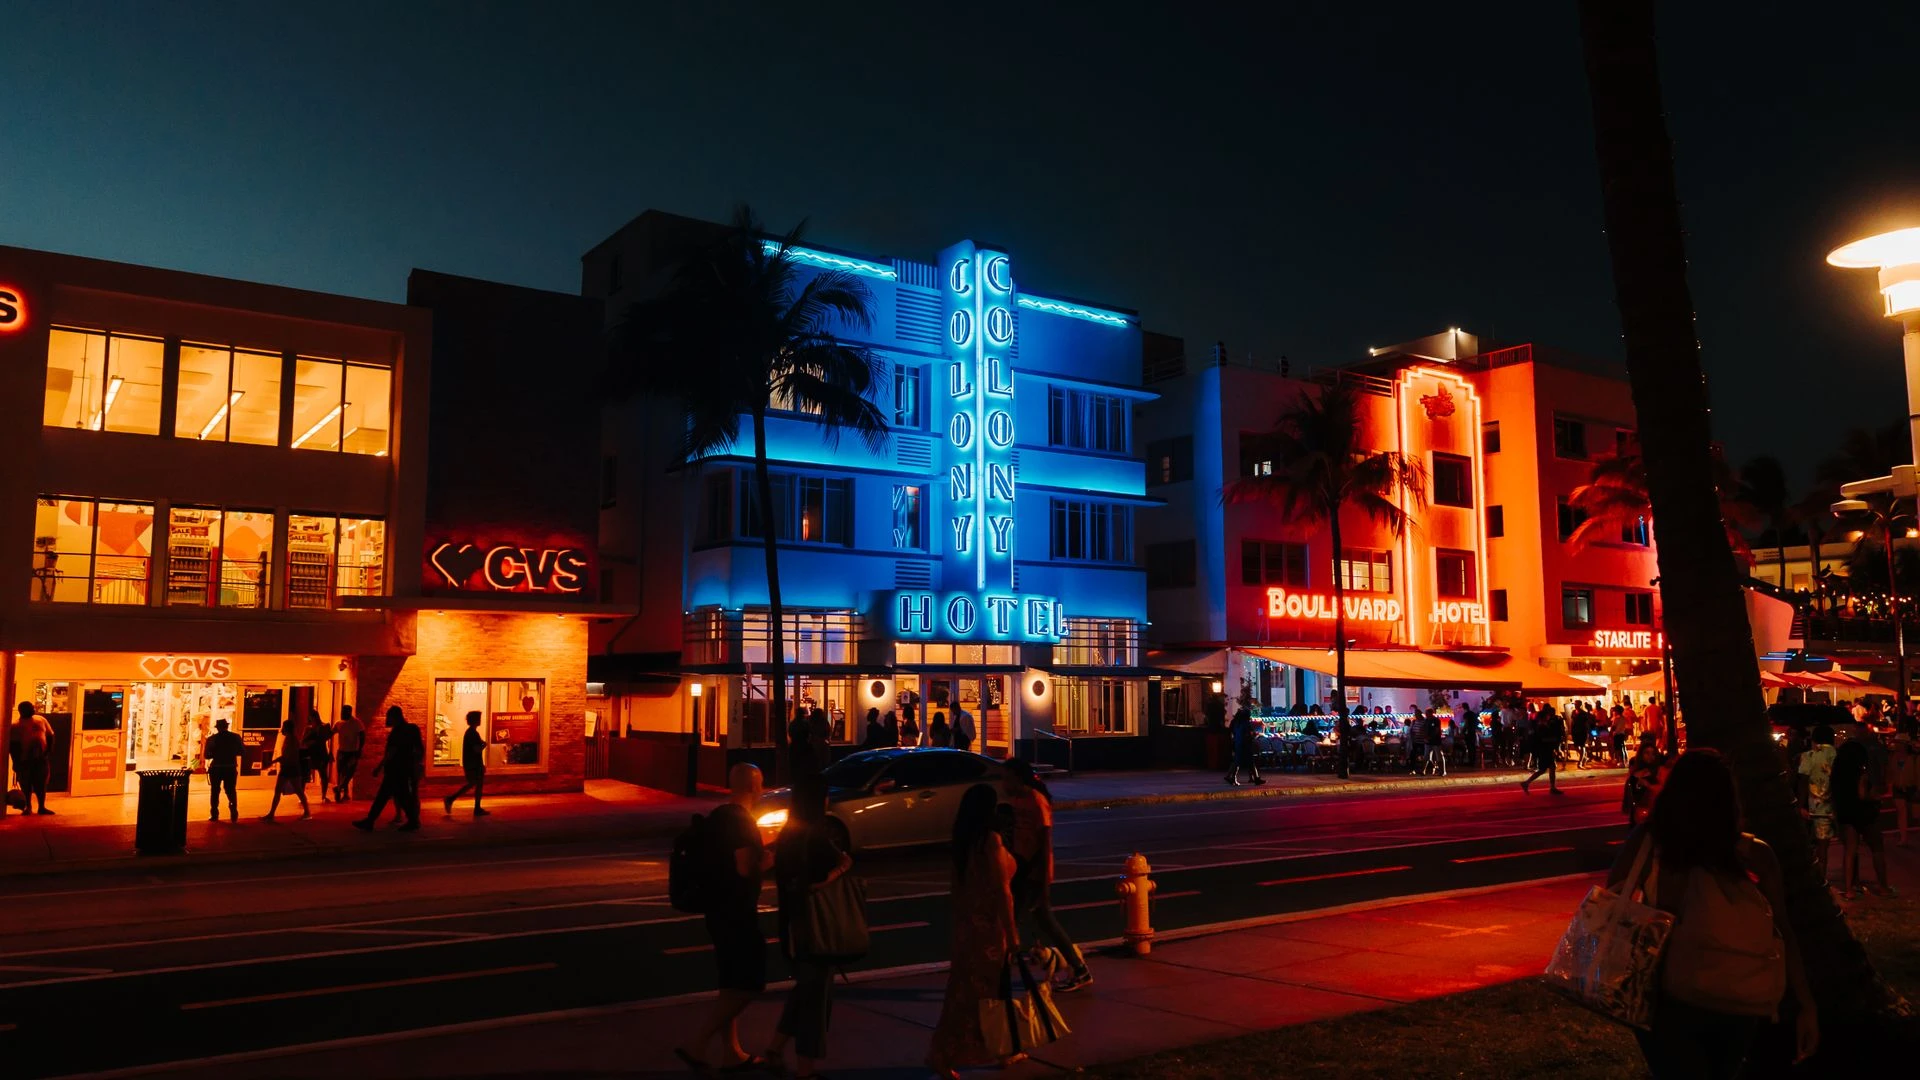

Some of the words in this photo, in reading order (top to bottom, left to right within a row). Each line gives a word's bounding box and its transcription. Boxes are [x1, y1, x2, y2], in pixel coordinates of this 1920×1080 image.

[951, 258, 971, 552] COLONY
[987, 256, 1014, 552] COLONY
[171, 527, 191, 535] SALE
[289, 533, 307, 541] SALE
[485, 545, 588, 592] CVS
[900, 595, 1070, 637] HOTEL
[1433, 601, 1488, 624] HOTEL
[1595, 630, 1651, 648] STARLITE
[172, 658, 230, 678] CVS
[95, 735, 117, 743] CVS
